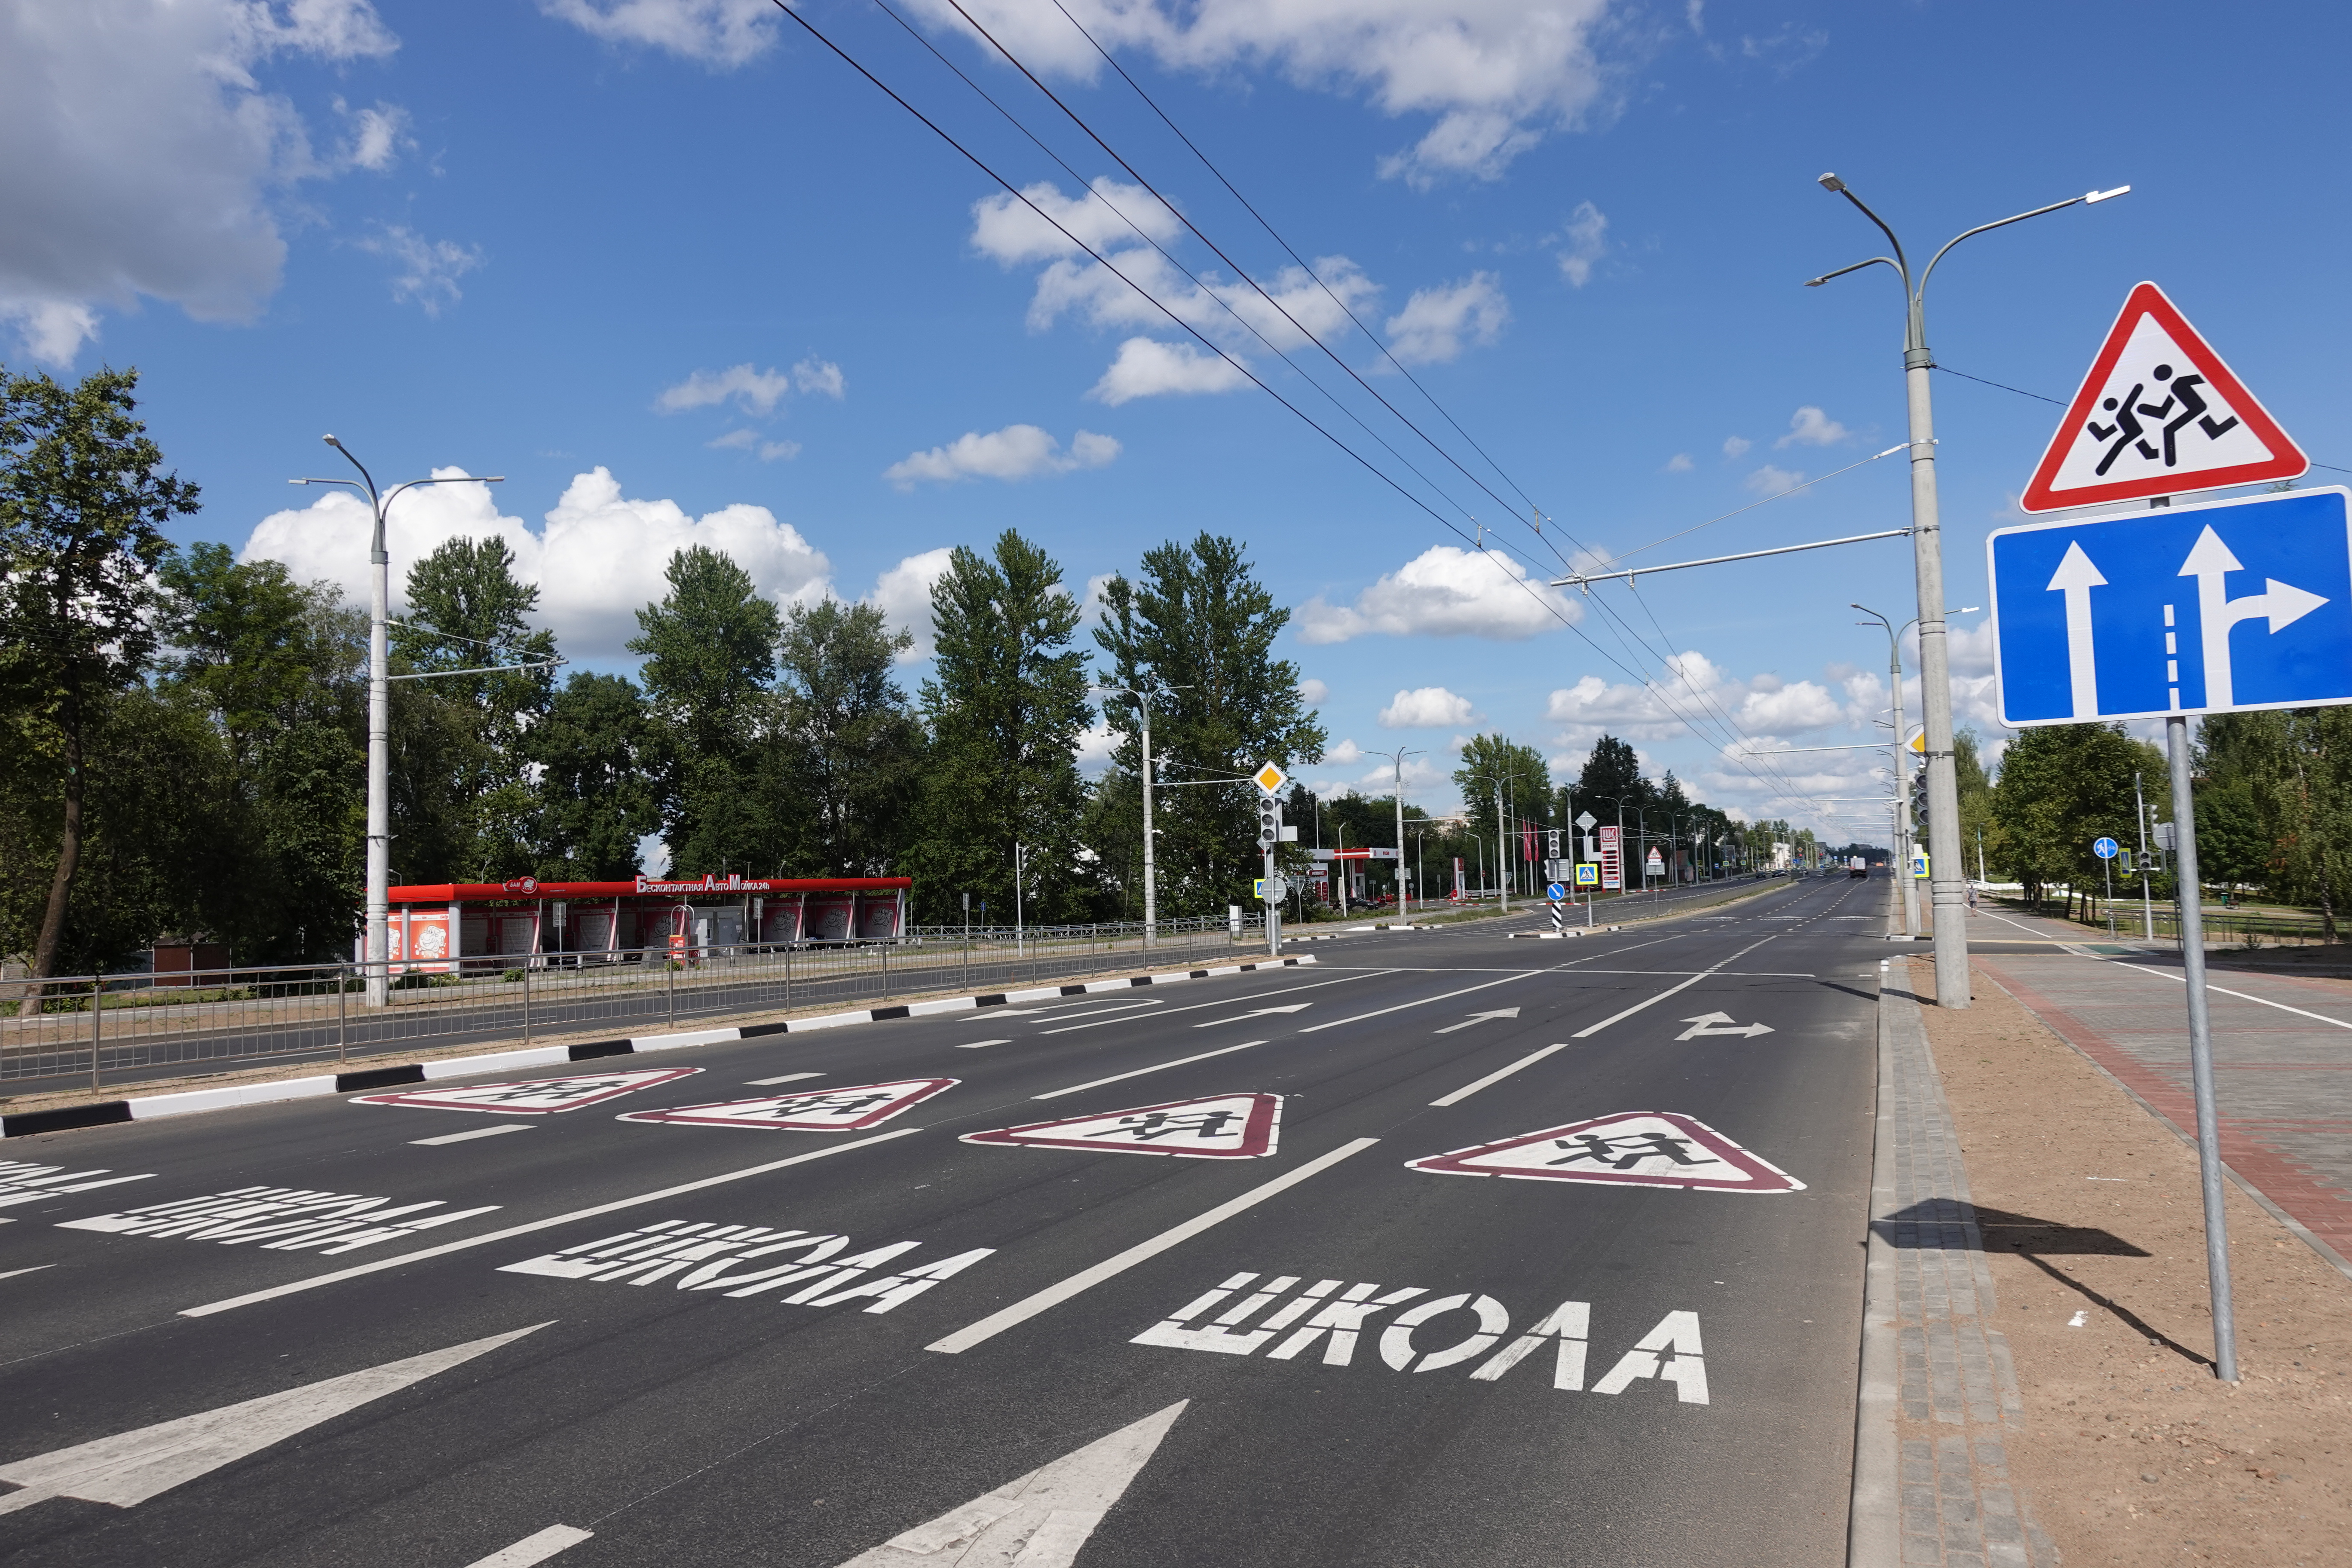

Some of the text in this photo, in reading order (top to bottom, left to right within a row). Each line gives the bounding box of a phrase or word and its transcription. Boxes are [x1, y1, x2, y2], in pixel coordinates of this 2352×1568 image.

[52, 1186, 504, 1255] ШКОЛА
[494, 1220, 998, 1314] ШКОЛА
[1128, 1272, 1710, 1405] ШКОЛА
